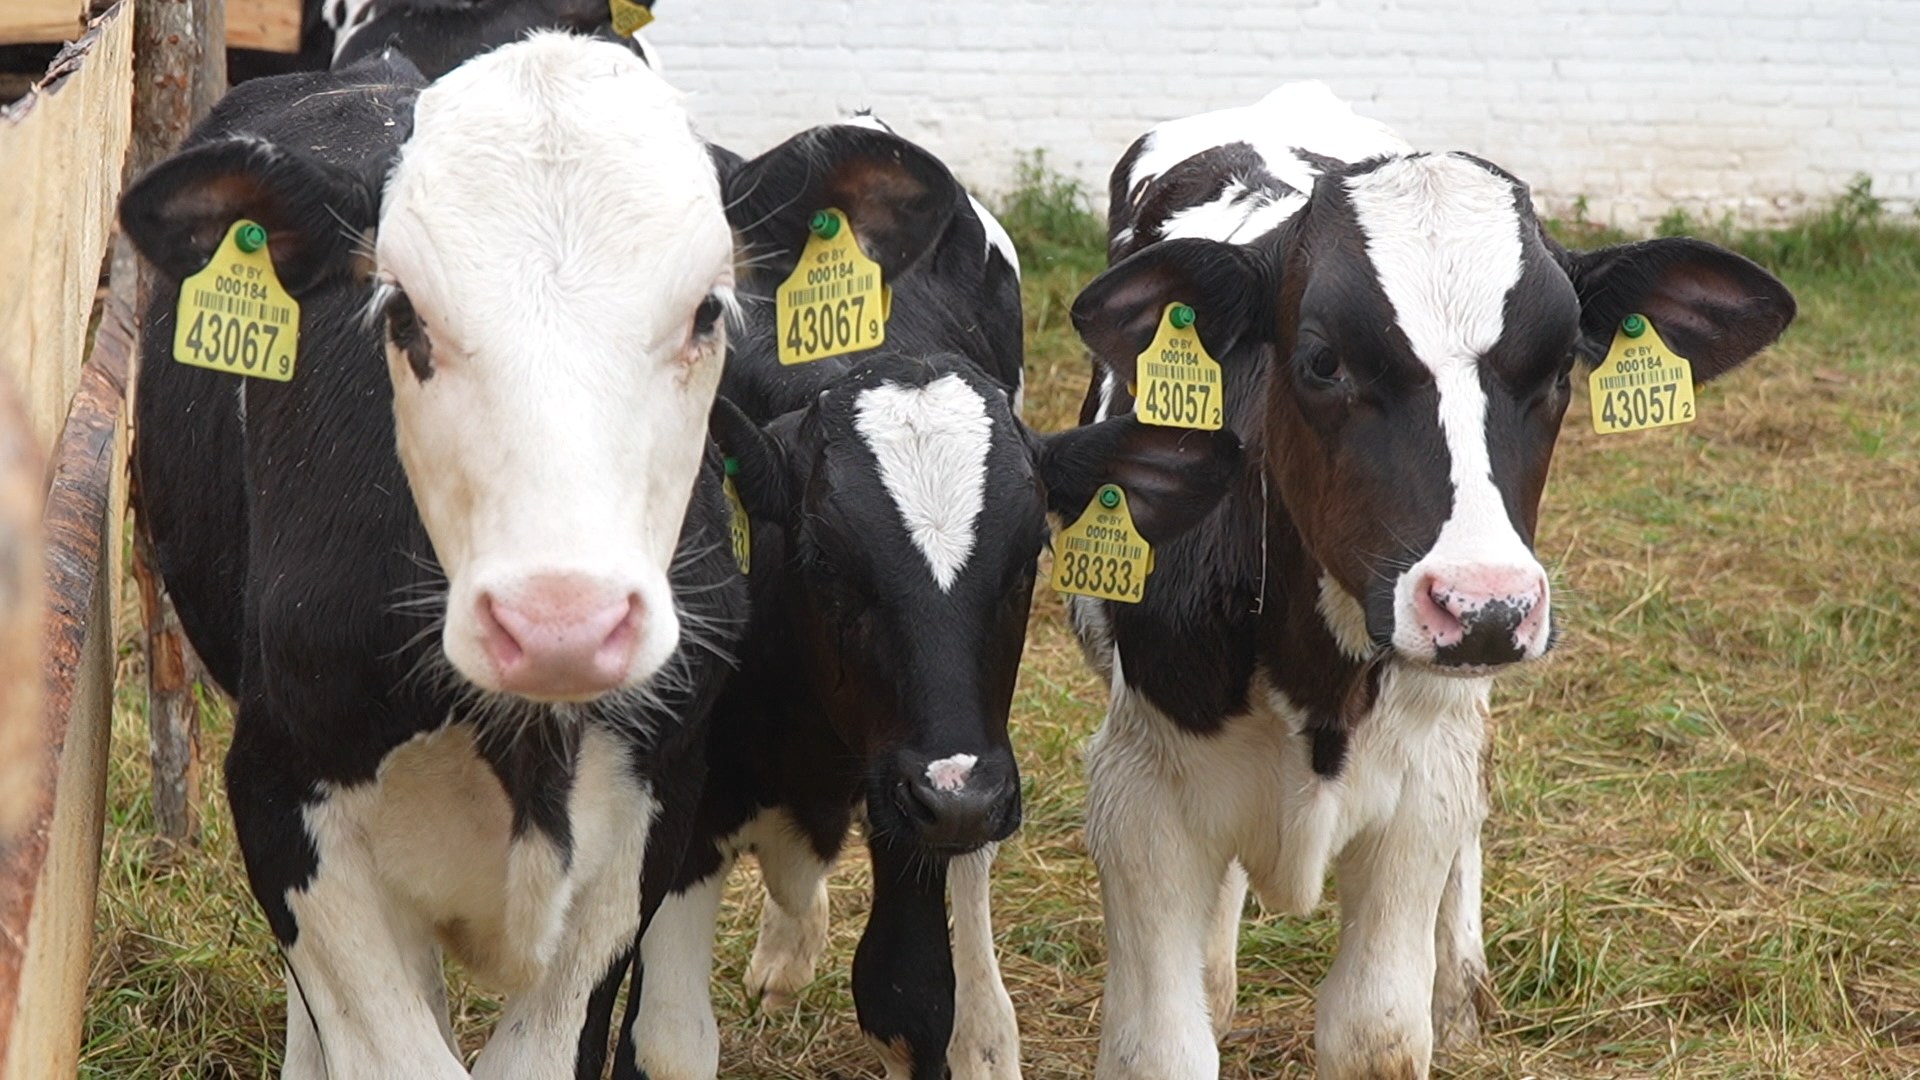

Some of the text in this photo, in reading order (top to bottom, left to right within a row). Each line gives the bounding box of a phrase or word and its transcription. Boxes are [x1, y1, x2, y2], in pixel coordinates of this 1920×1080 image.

[215, 275, 267, 300] 000184
[807, 260, 854, 285] 000184
[185, 310, 279, 372] 43067
[786, 296, 865, 356] 43067
[1616, 355, 1662, 373] 000184
[1145, 379, 1211, 424] 43057
[1601, 383, 1677, 429] 43057
[1060, 551, 1132, 596] 38333
